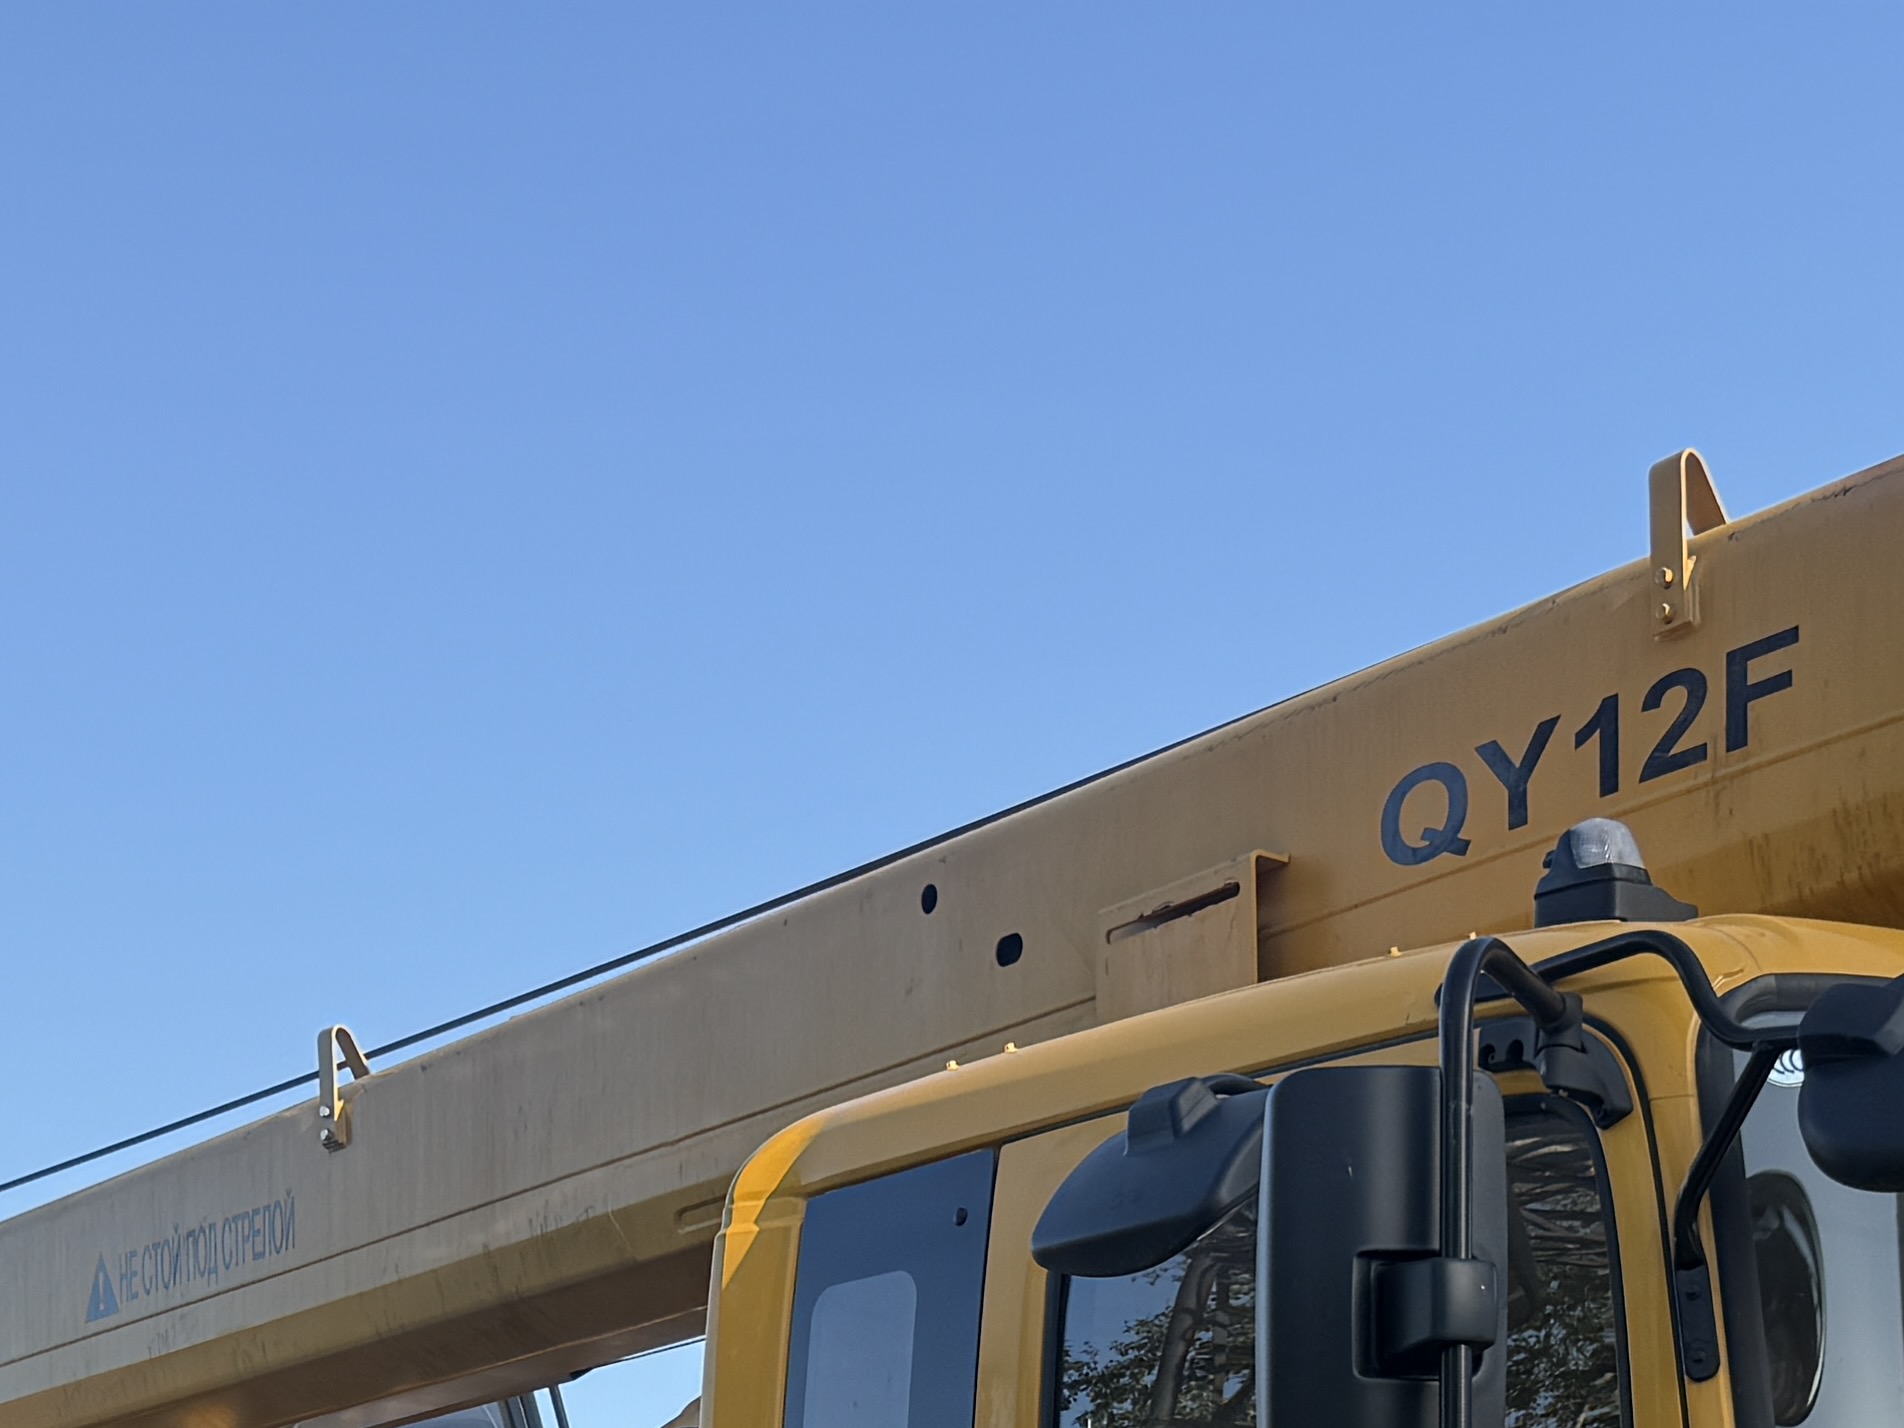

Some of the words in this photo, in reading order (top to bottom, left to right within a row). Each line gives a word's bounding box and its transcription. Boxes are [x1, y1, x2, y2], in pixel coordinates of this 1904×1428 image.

[1380, 625, 1800, 866] QY12F
[119, 1248, 139, 1305] НЕ
[142, 1223, 182, 1296] СТОЙ
[185, 1222, 218, 1287] ПОД
[222, 1188, 295, 1271] СТРЕЛОЙ
